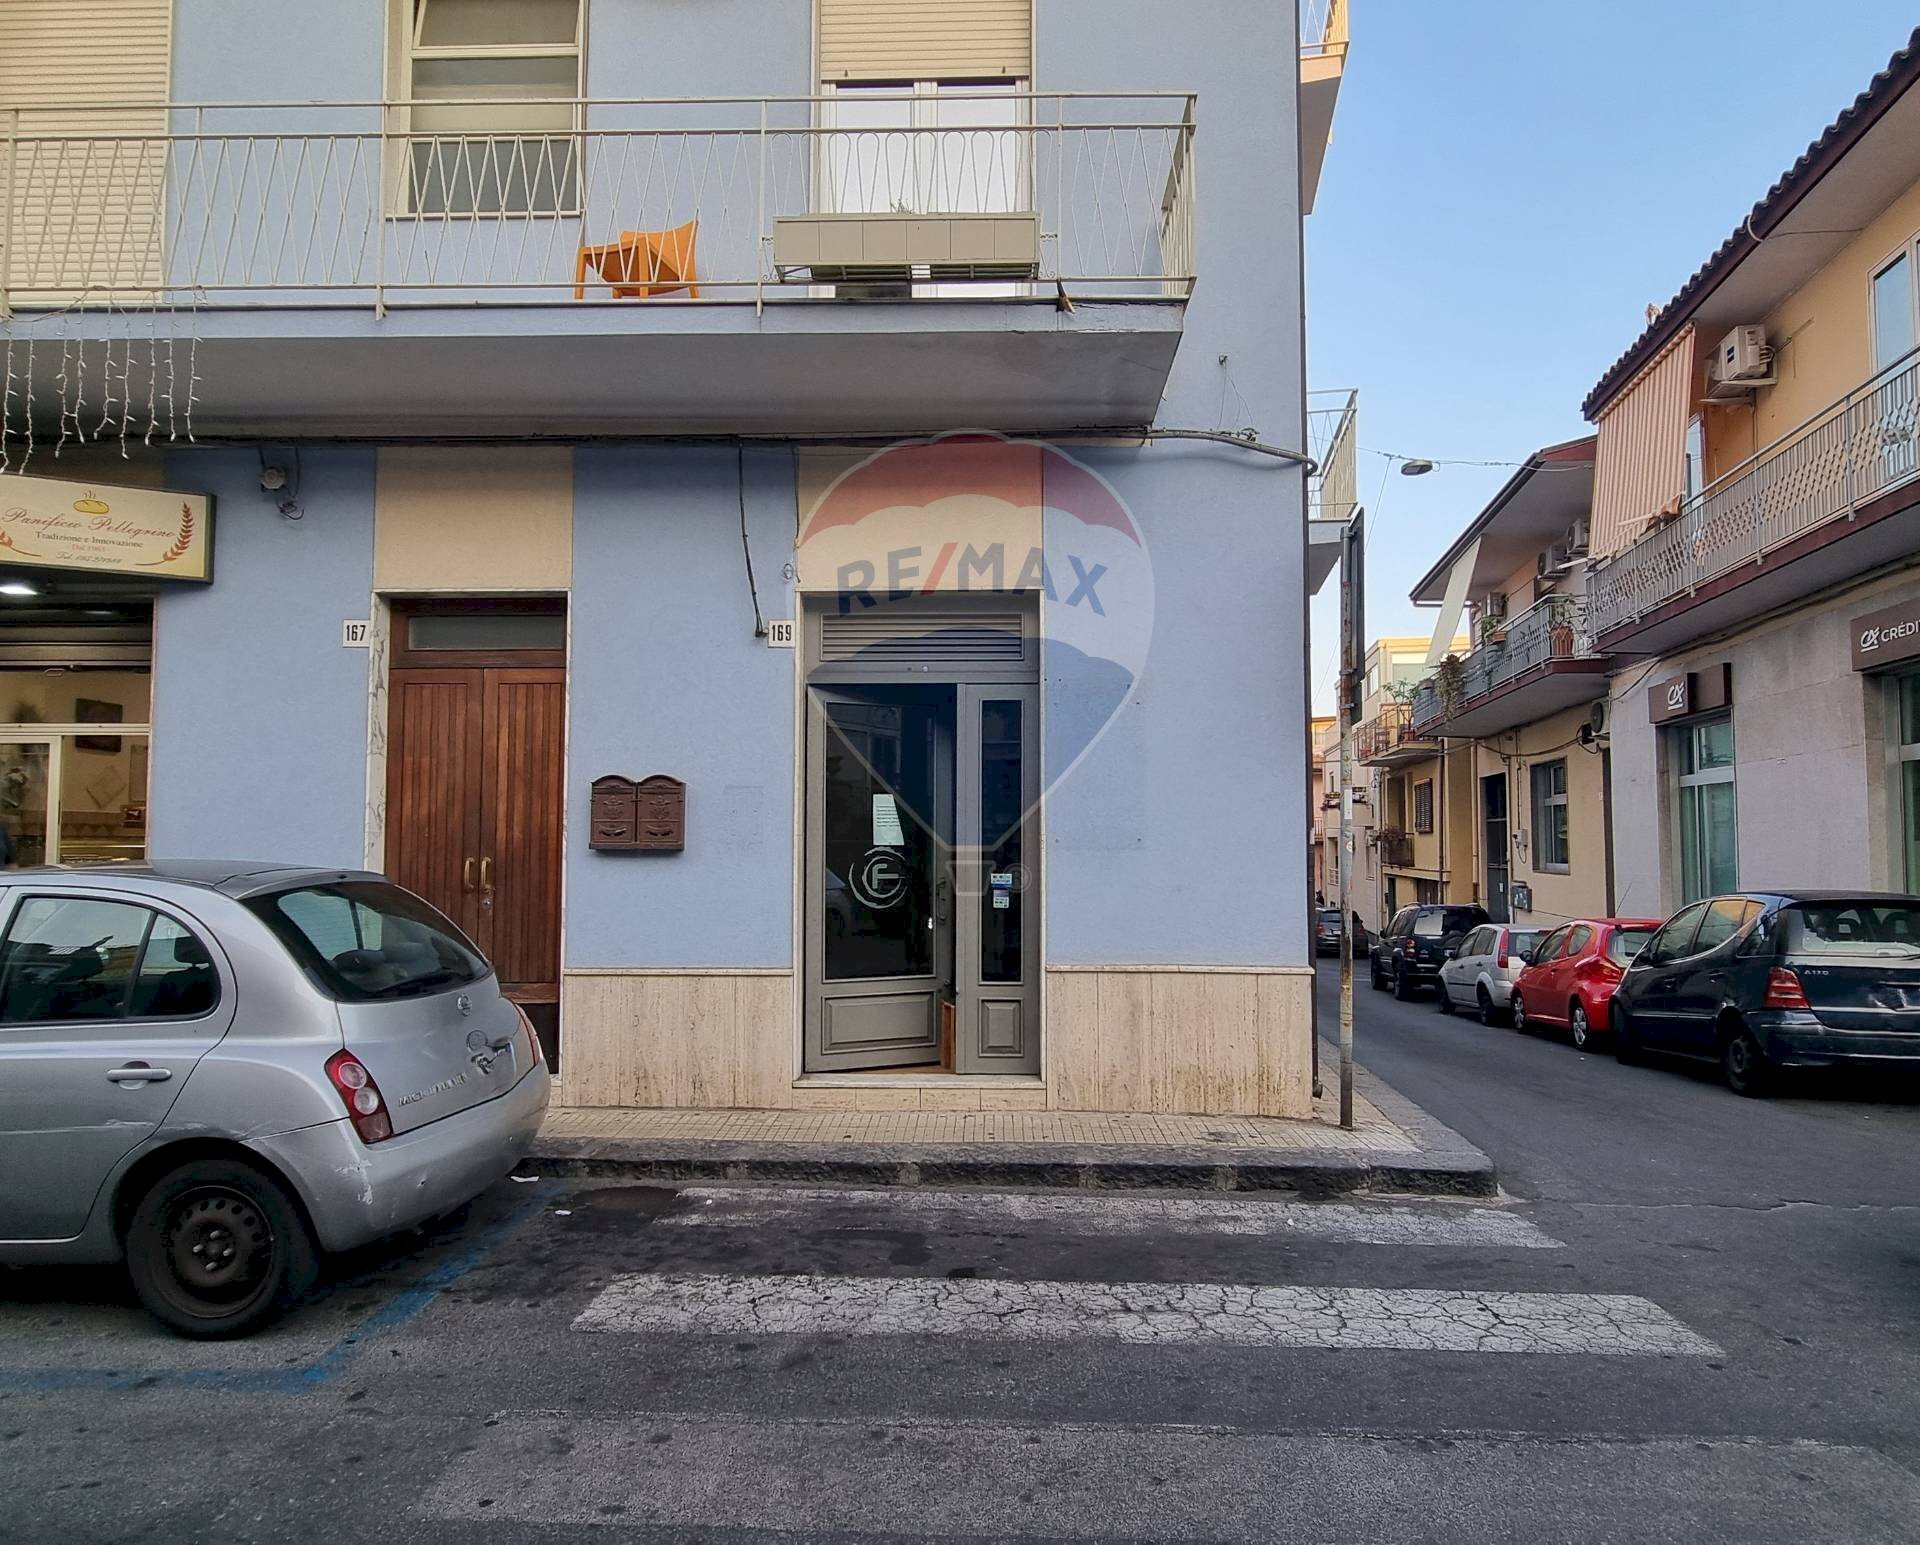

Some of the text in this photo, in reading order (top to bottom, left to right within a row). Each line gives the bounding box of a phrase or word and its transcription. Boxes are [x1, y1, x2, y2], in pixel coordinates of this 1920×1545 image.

[1, 506, 175, 539] Panificio Pellegrino
[35, 530, 82, 542] Tradizione
[92, 536, 144, 548] Innovazione
[346, 625, 366, 641] 167
[772, 625, 792, 641] 169
